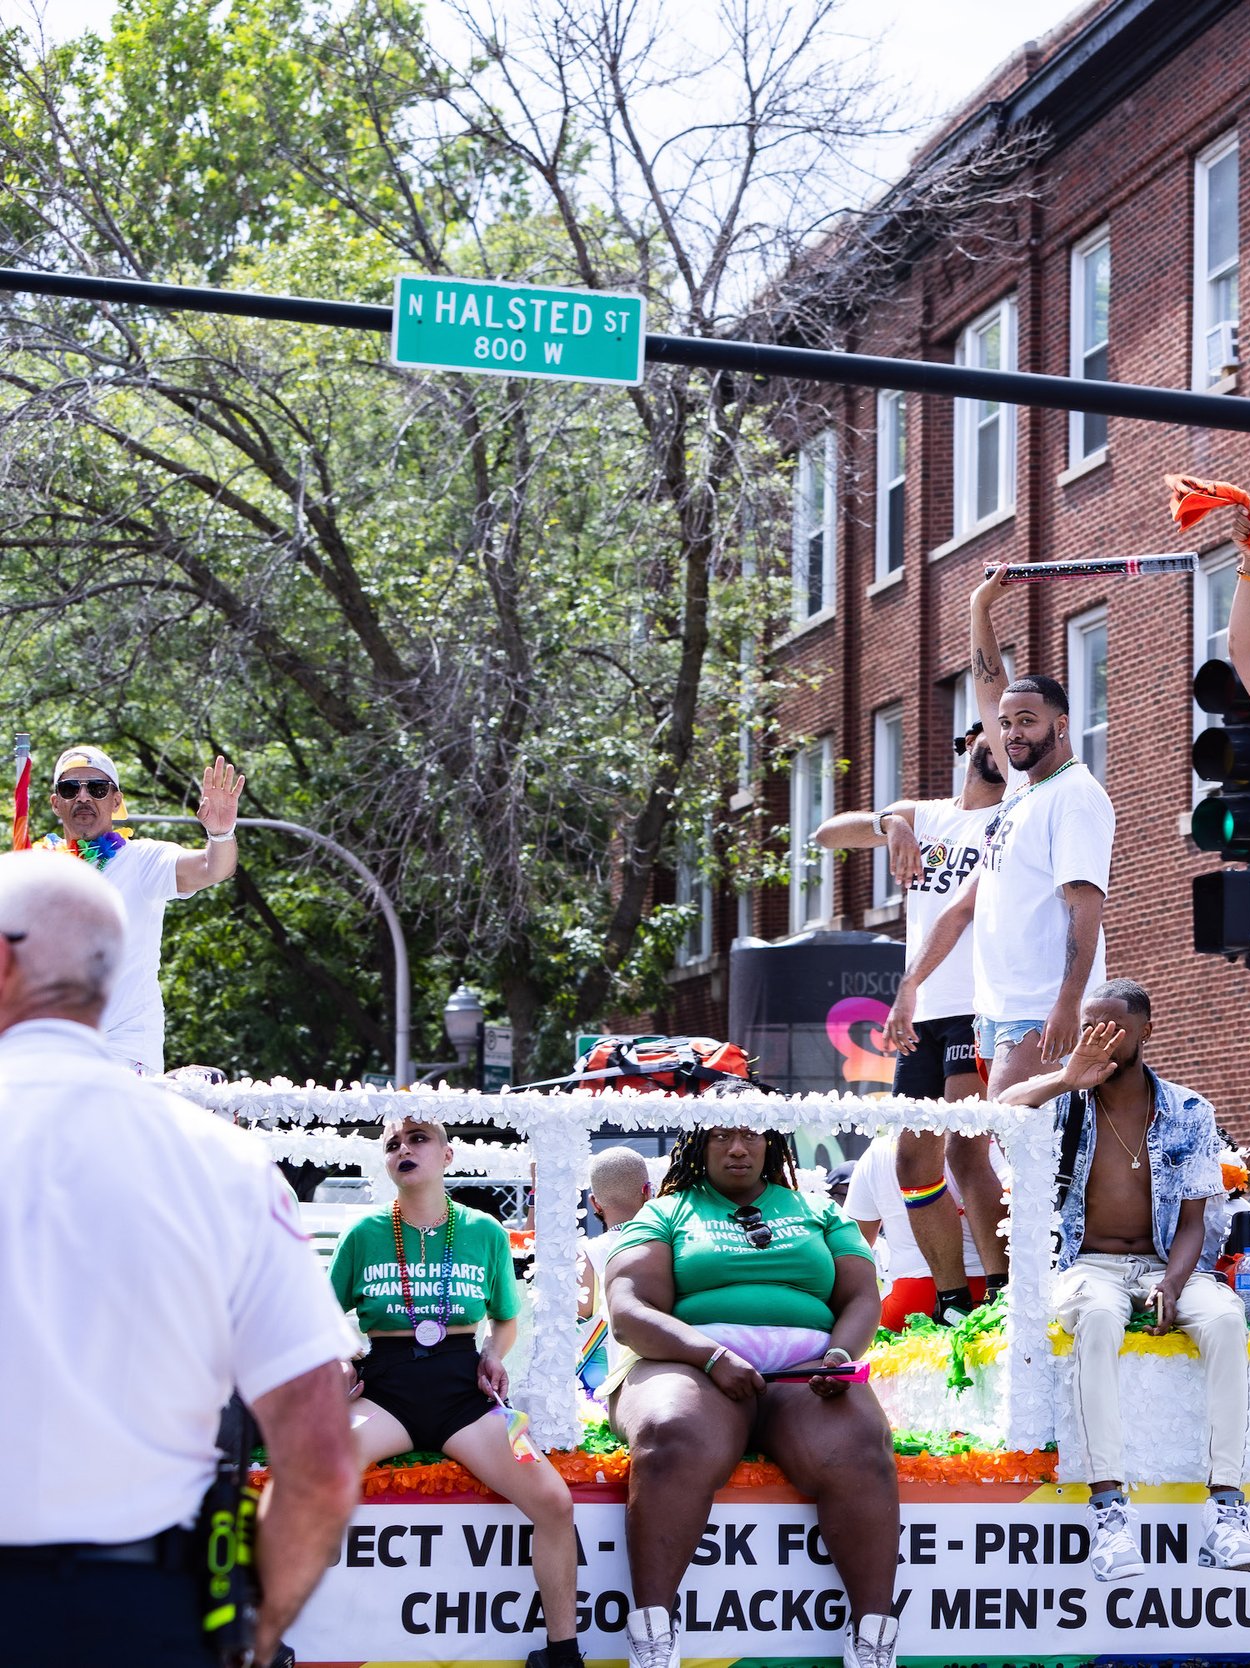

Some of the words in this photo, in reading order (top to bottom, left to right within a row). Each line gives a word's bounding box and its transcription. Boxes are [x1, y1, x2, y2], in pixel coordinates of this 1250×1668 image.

[409, 294, 422, 316] N
[435, 291, 593, 335] HALSTED
[604, 311, 630, 333] ST
[474, 336, 527, 362] 800
[544, 342, 563, 364] W
[771, 1225, 811, 1241] LIVES
[448, 1282, 485, 1300] LIVES
[386, 1304, 393, 1314] A
[462, 1524, 588, 1567] VID
[599, 1541, 615, 1551] -
[690, 1524, 757, 1565] SK
[948, 1540, 964, 1551] -
[975, 1523, 1091, 1564] PRID
[1141, 1523, 1188, 1564] IN
[931, 1587, 1087, 1630] MEN'S
